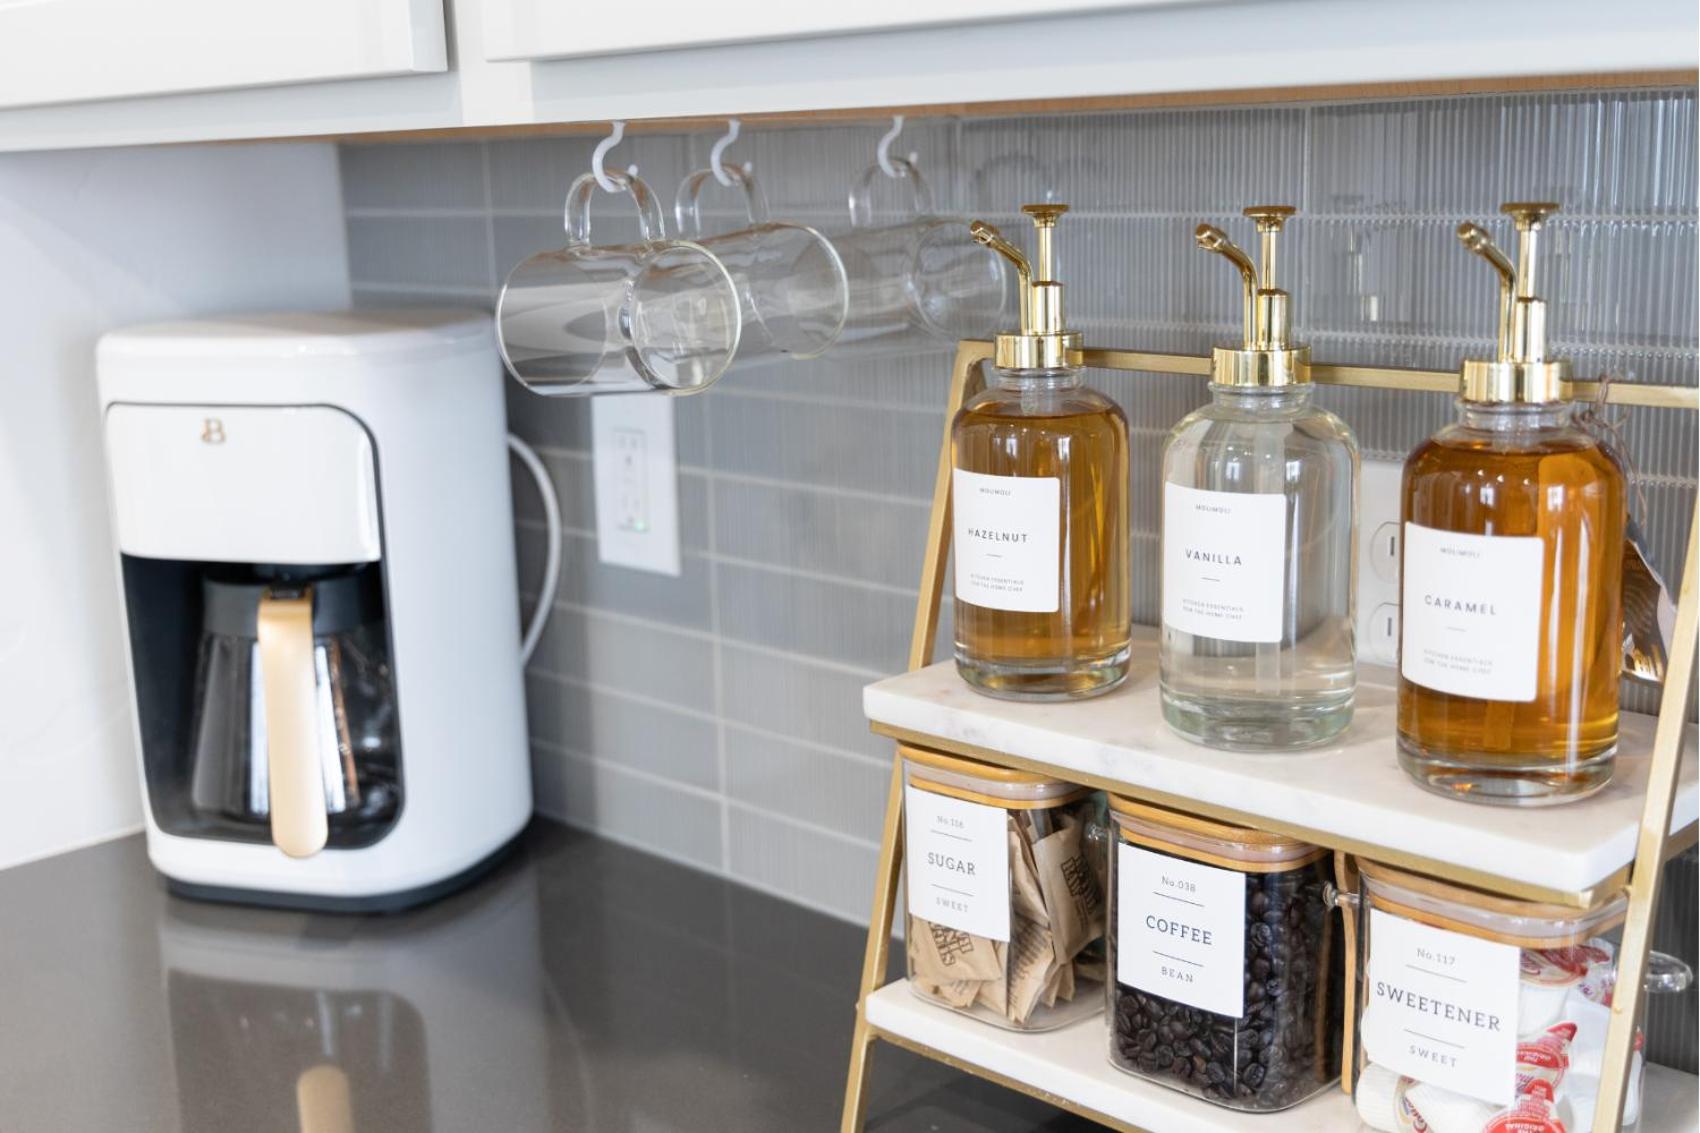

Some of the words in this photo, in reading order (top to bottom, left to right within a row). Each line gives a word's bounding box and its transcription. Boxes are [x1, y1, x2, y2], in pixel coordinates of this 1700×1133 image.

[968, 527, 1028, 543] HAZELNUT
[1185, 549, 1242, 566] VANILLA
[1424, 594, 1497, 616] CARAMEL
[927, 852, 976, 876] SUGAR
[1161, 875, 1196, 892] No.038
[936, 897, 969, 912] SWEET
[1146, 915, 1212, 945] COFFEE
[1417, 948, 1456, 965] No.117
[1161, 966, 1194, 983] BEAN
[1376, 981, 1500, 1032] SWEETENER
[1409, 1045, 1457, 1067] SWEET
